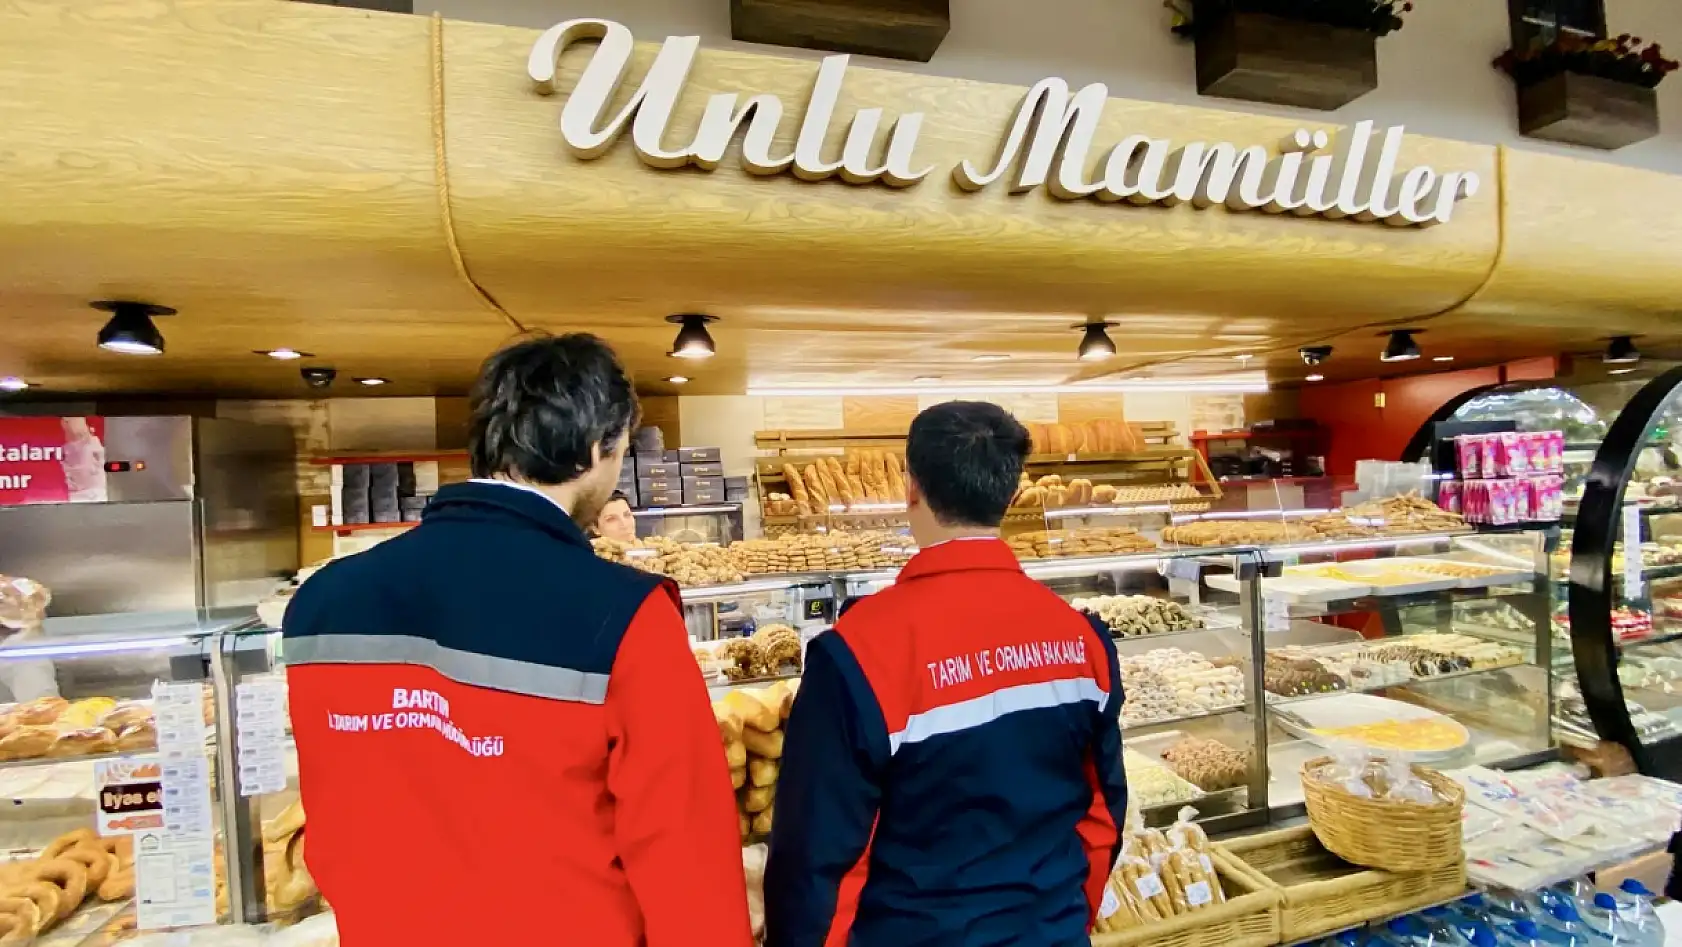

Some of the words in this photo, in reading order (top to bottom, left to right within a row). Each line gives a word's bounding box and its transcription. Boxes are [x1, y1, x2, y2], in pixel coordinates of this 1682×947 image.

[527, 17, 935, 185] Unlu
[953, 76, 1480, 224] Mamüller
[927, 654, 973, 690] TARIM
[975, 649, 994, 677] VE
[995, 641, 1043, 671] ORMAN
[372, 712, 395, 731] VE
